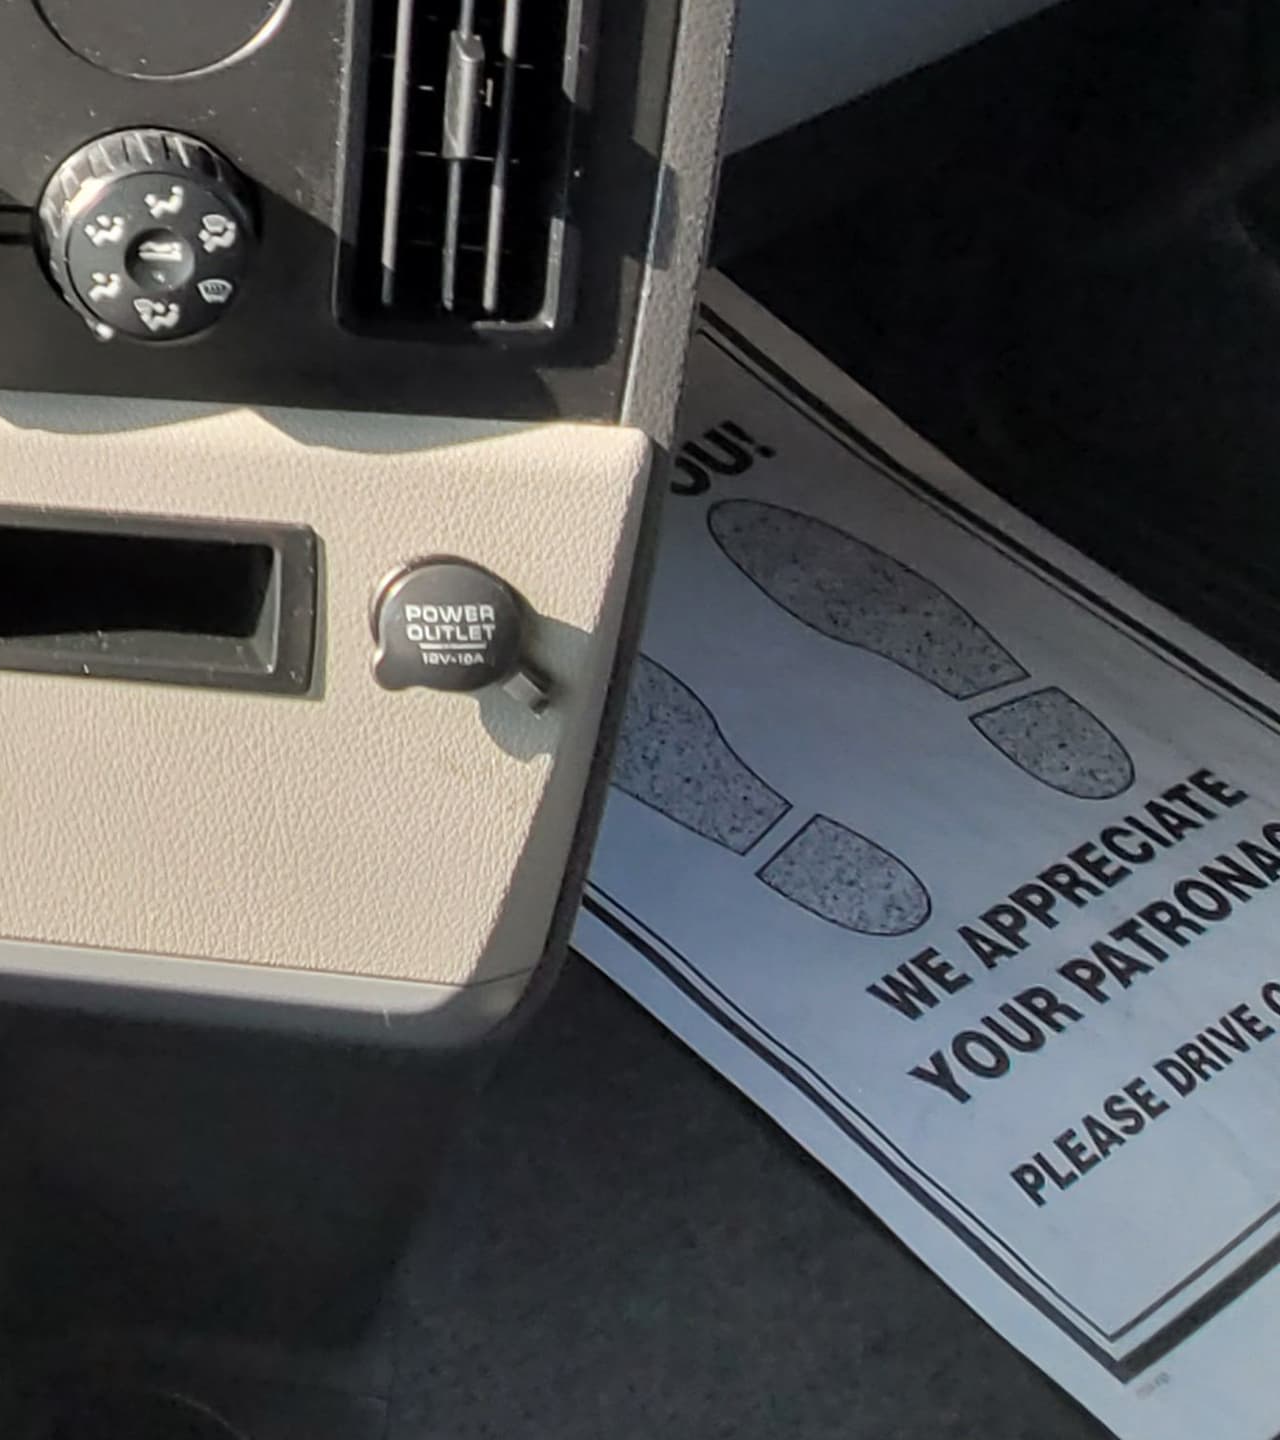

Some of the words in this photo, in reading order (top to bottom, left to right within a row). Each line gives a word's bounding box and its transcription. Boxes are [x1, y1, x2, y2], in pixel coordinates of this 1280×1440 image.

[405, 604, 495, 623] POWER
[406, 623, 496, 641] OUTLET
[865, 946, 974, 1022] WE
[957, 767, 1248, 970] APPRECIATE
[906, 986, 1085, 1104] YOUR
[1010, 1077, 1170, 1208] PLEASE
[1152, 1003, 1276, 1098] DRIVE
